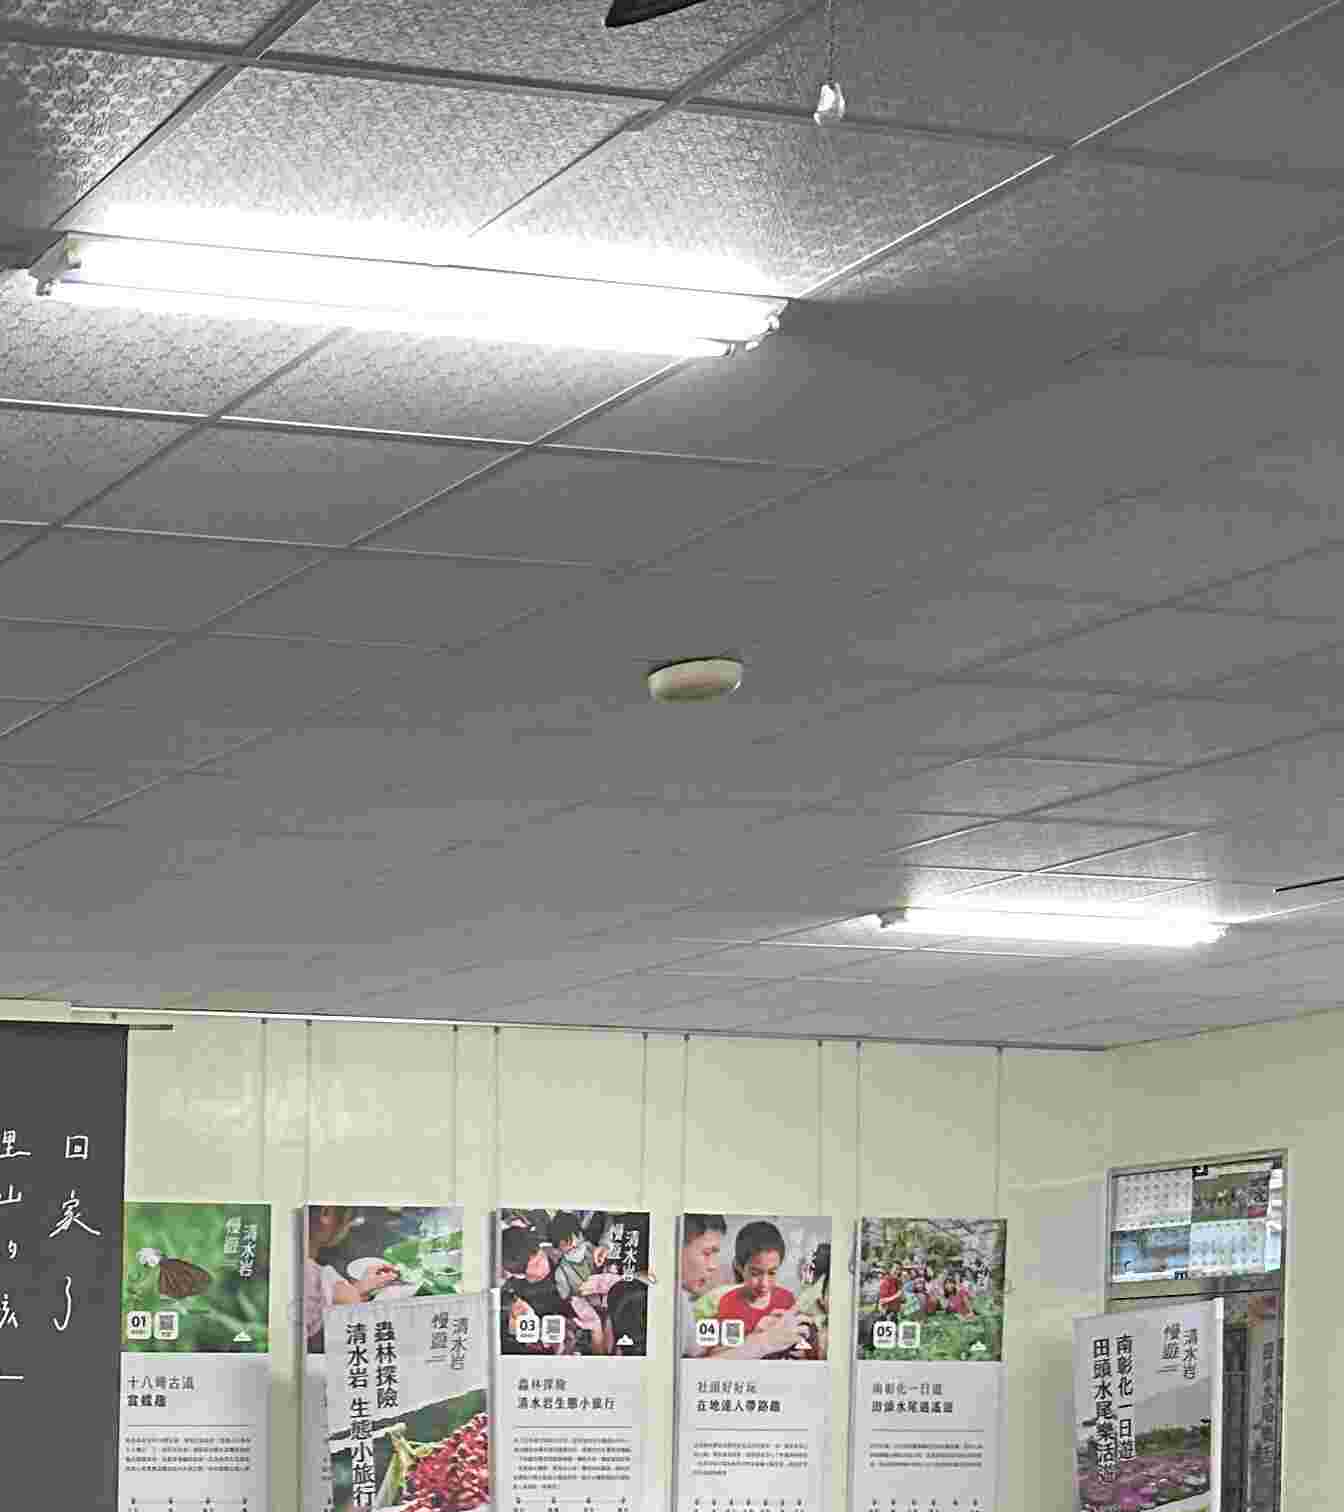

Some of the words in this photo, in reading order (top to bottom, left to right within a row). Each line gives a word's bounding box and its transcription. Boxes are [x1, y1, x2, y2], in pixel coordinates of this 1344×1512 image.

[48, 1135, 103, 1331] 回家了
[132, 1315, 146, 1328] 01
[519, 1319, 536, 1333] 03
[699, 1323, 716, 1336] 04
[876, 1326, 893, 1338] 05
[346, 1322, 369, 1389] 清水岩
[450, 1317, 470, 1371] 清水岩
[1115, 1332, 1135, 1458] 南彰化一日遊
